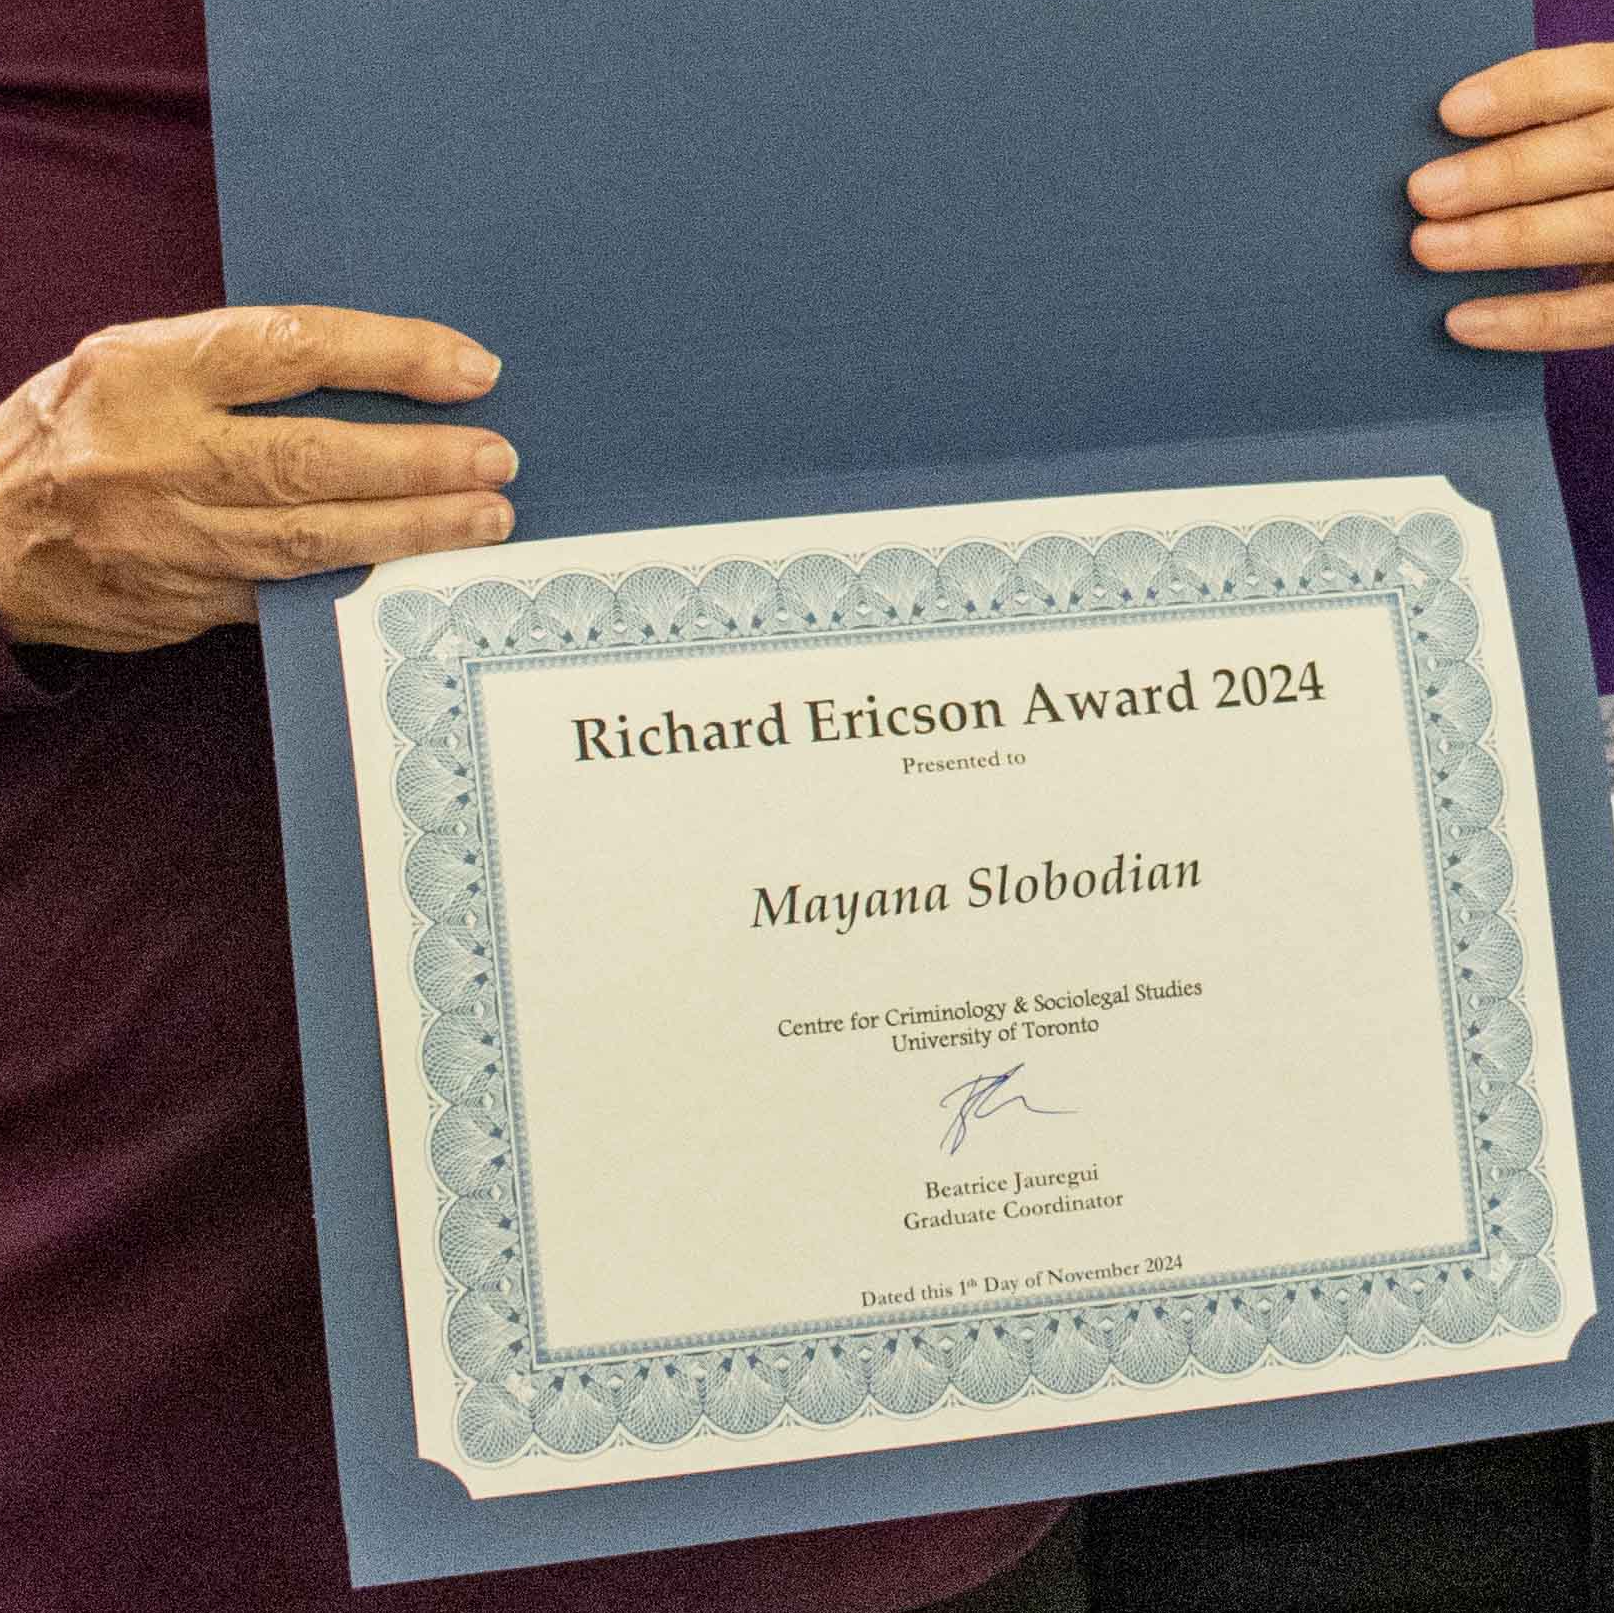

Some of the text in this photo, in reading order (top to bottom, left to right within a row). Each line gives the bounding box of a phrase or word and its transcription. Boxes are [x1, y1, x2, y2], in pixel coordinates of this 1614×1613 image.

[572, 660, 1327, 762] Richard Ericson Award 2024
[902, 751, 1027, 775] Presented to
[751, 853, 1202, 935] Mayana Slobodian
[778, 979, 1202, 1038] Centre for Criminology & Sociolegal Studies
[892, 1017, 1100, 1052] University of Toronto
[925, 1164, 1099, 1199] Beatrice Jauregui
[903, 1193, 1124, 1231] Graduate Coordinator
[861, 1285, 915, 1307] Dated
[921, 1284, 953, 1300] this
[984, 1276, 1019, 1294] Day
[1025, 1271, 1043, 1288] of
[1047, 1263, 1140, 1285] November
[1145, 1255, 1183, 1273] 2024
